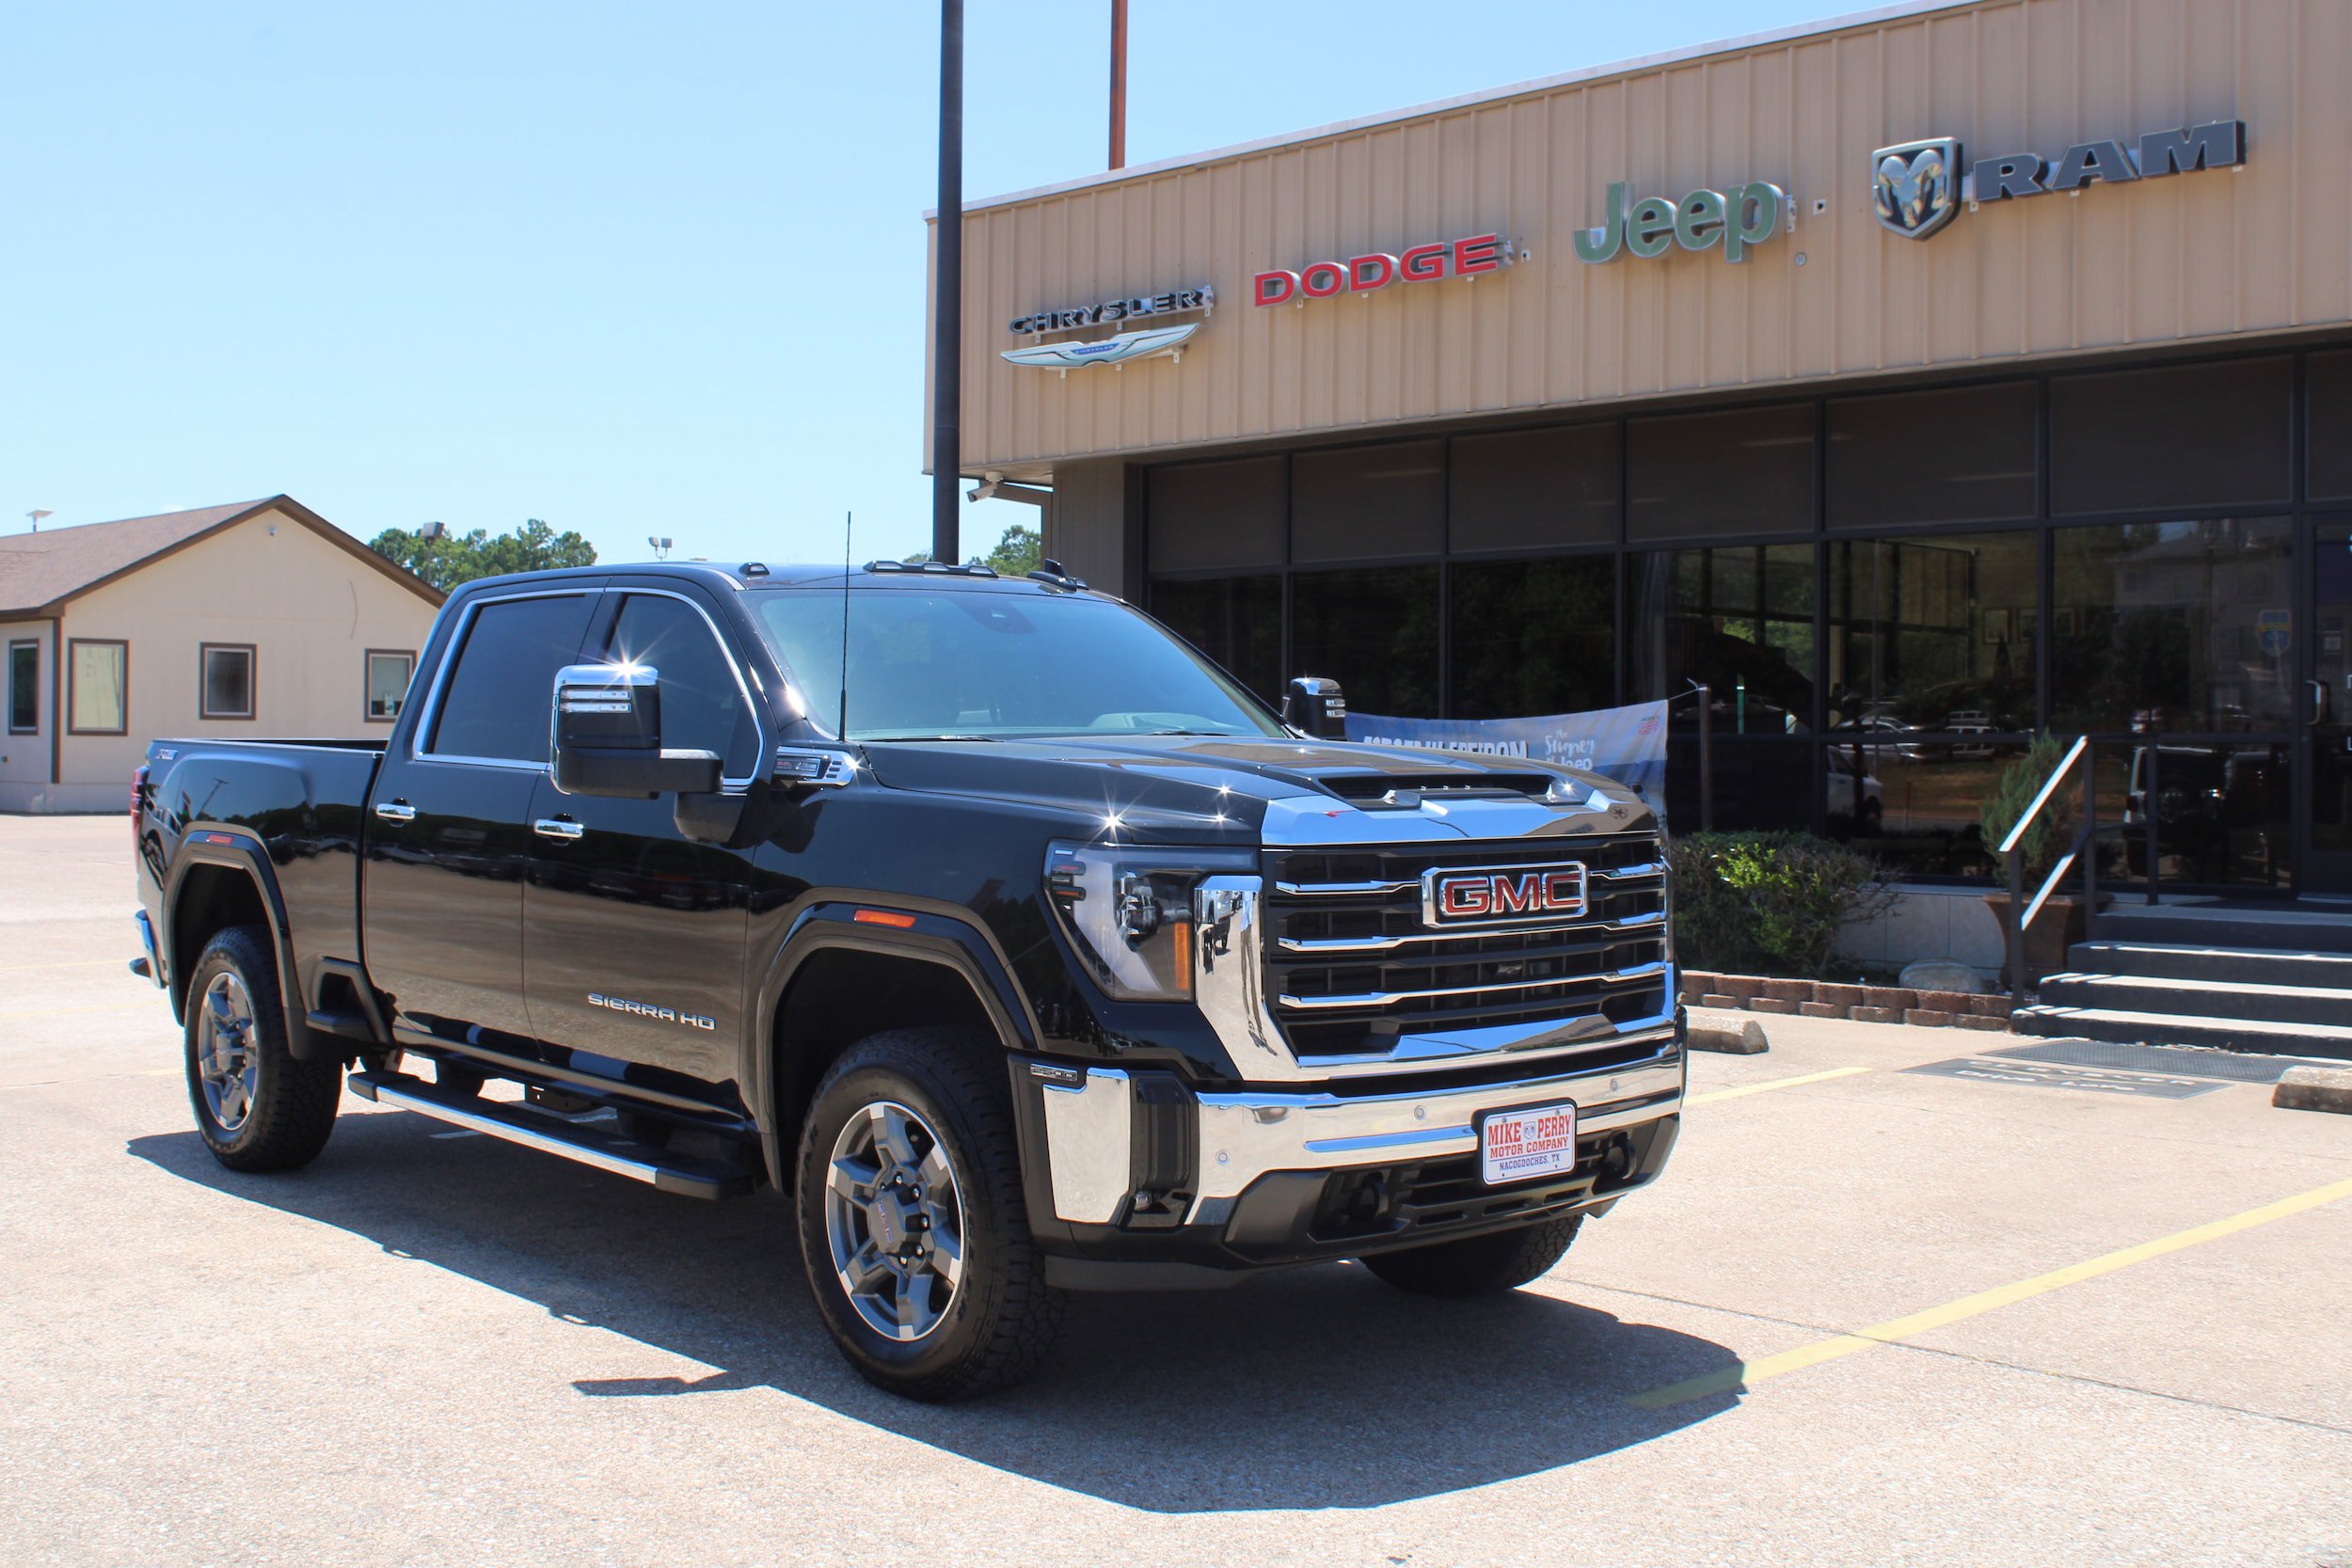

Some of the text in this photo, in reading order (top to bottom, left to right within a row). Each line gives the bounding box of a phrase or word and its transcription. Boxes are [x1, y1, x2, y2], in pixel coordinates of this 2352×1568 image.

[1973, 119, 2239, 201] RAM
[1572, 181, 1780, 264] Jeep
[1254, 232, 1500, 308] DODGE
[1009, 289, 1201, 335] CHRYSLER
[1439, 872, 1583, 916] GMC
[587, 992, 716, 1031] SIERRA HD
[1487, 1114, 1571, 1147] MIKE PERRY
[1490, 1136, 1568, 1159] MOTOR COMPANY
[1551, 1153, 1560, 1163] TX
